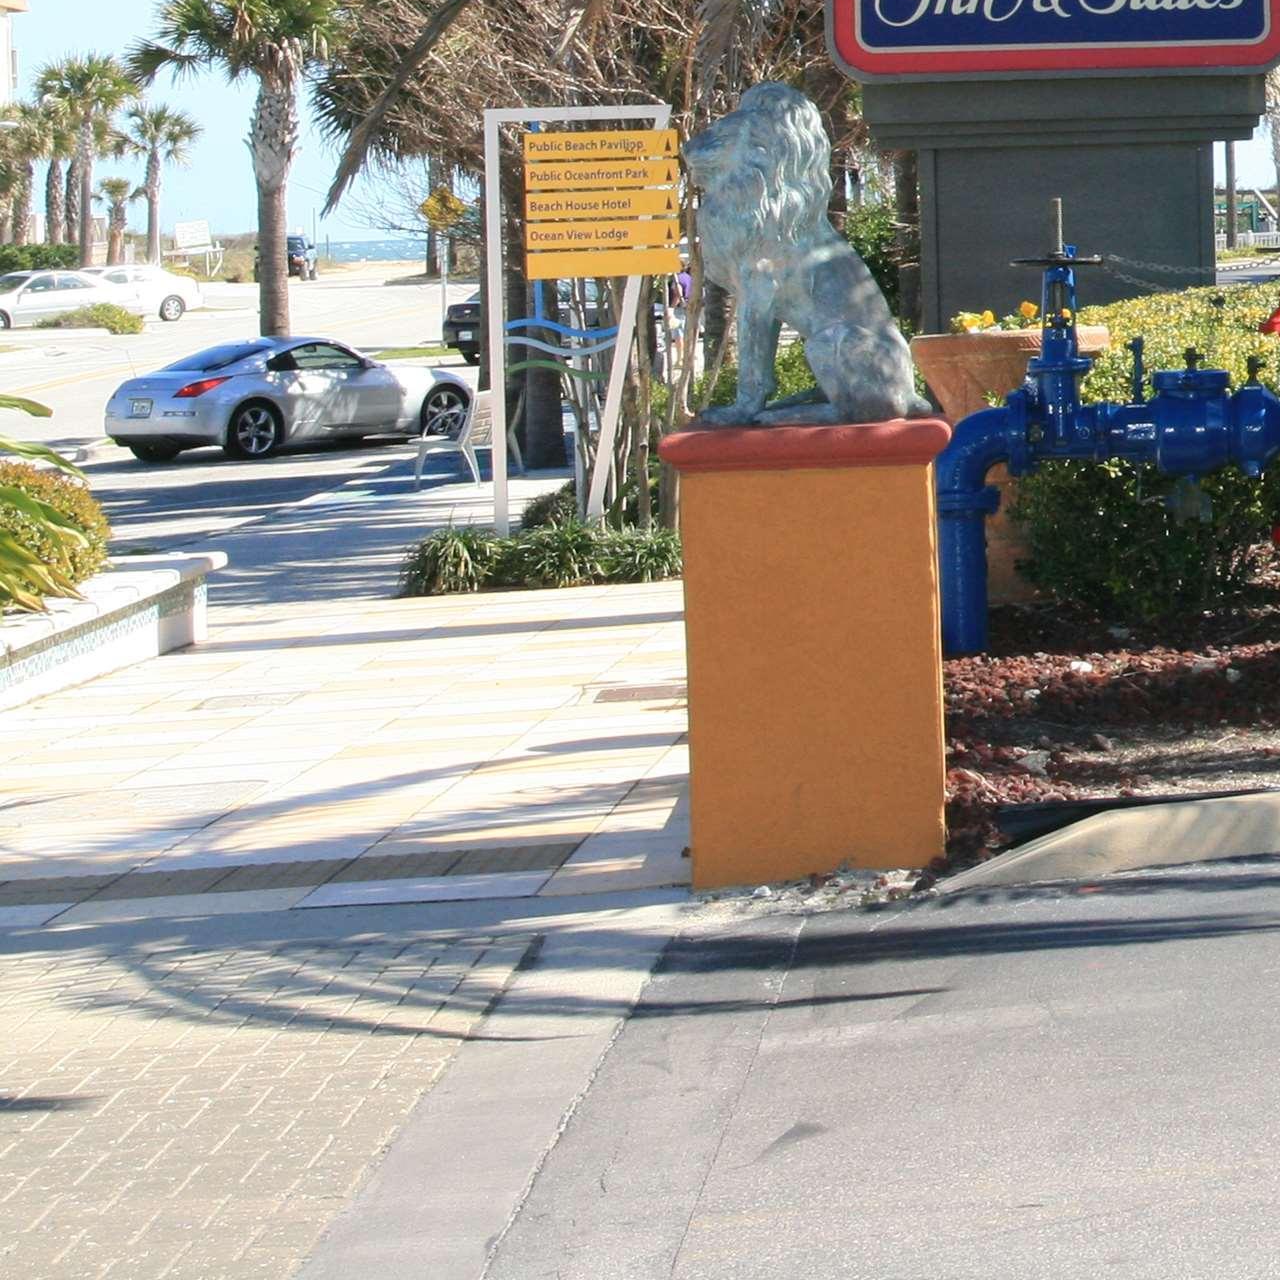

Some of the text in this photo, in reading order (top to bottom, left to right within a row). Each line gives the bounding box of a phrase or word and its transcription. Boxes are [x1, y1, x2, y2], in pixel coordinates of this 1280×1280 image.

[528, 141, 561, 152] Public
[564, 140, 598, 151] Beach
[529, 168, 649, 181] Public Oceanfront Park
[529, 198, 631, 211] Beach House Hotel
[530, 228, 629, 241] Ocean View Lodge
